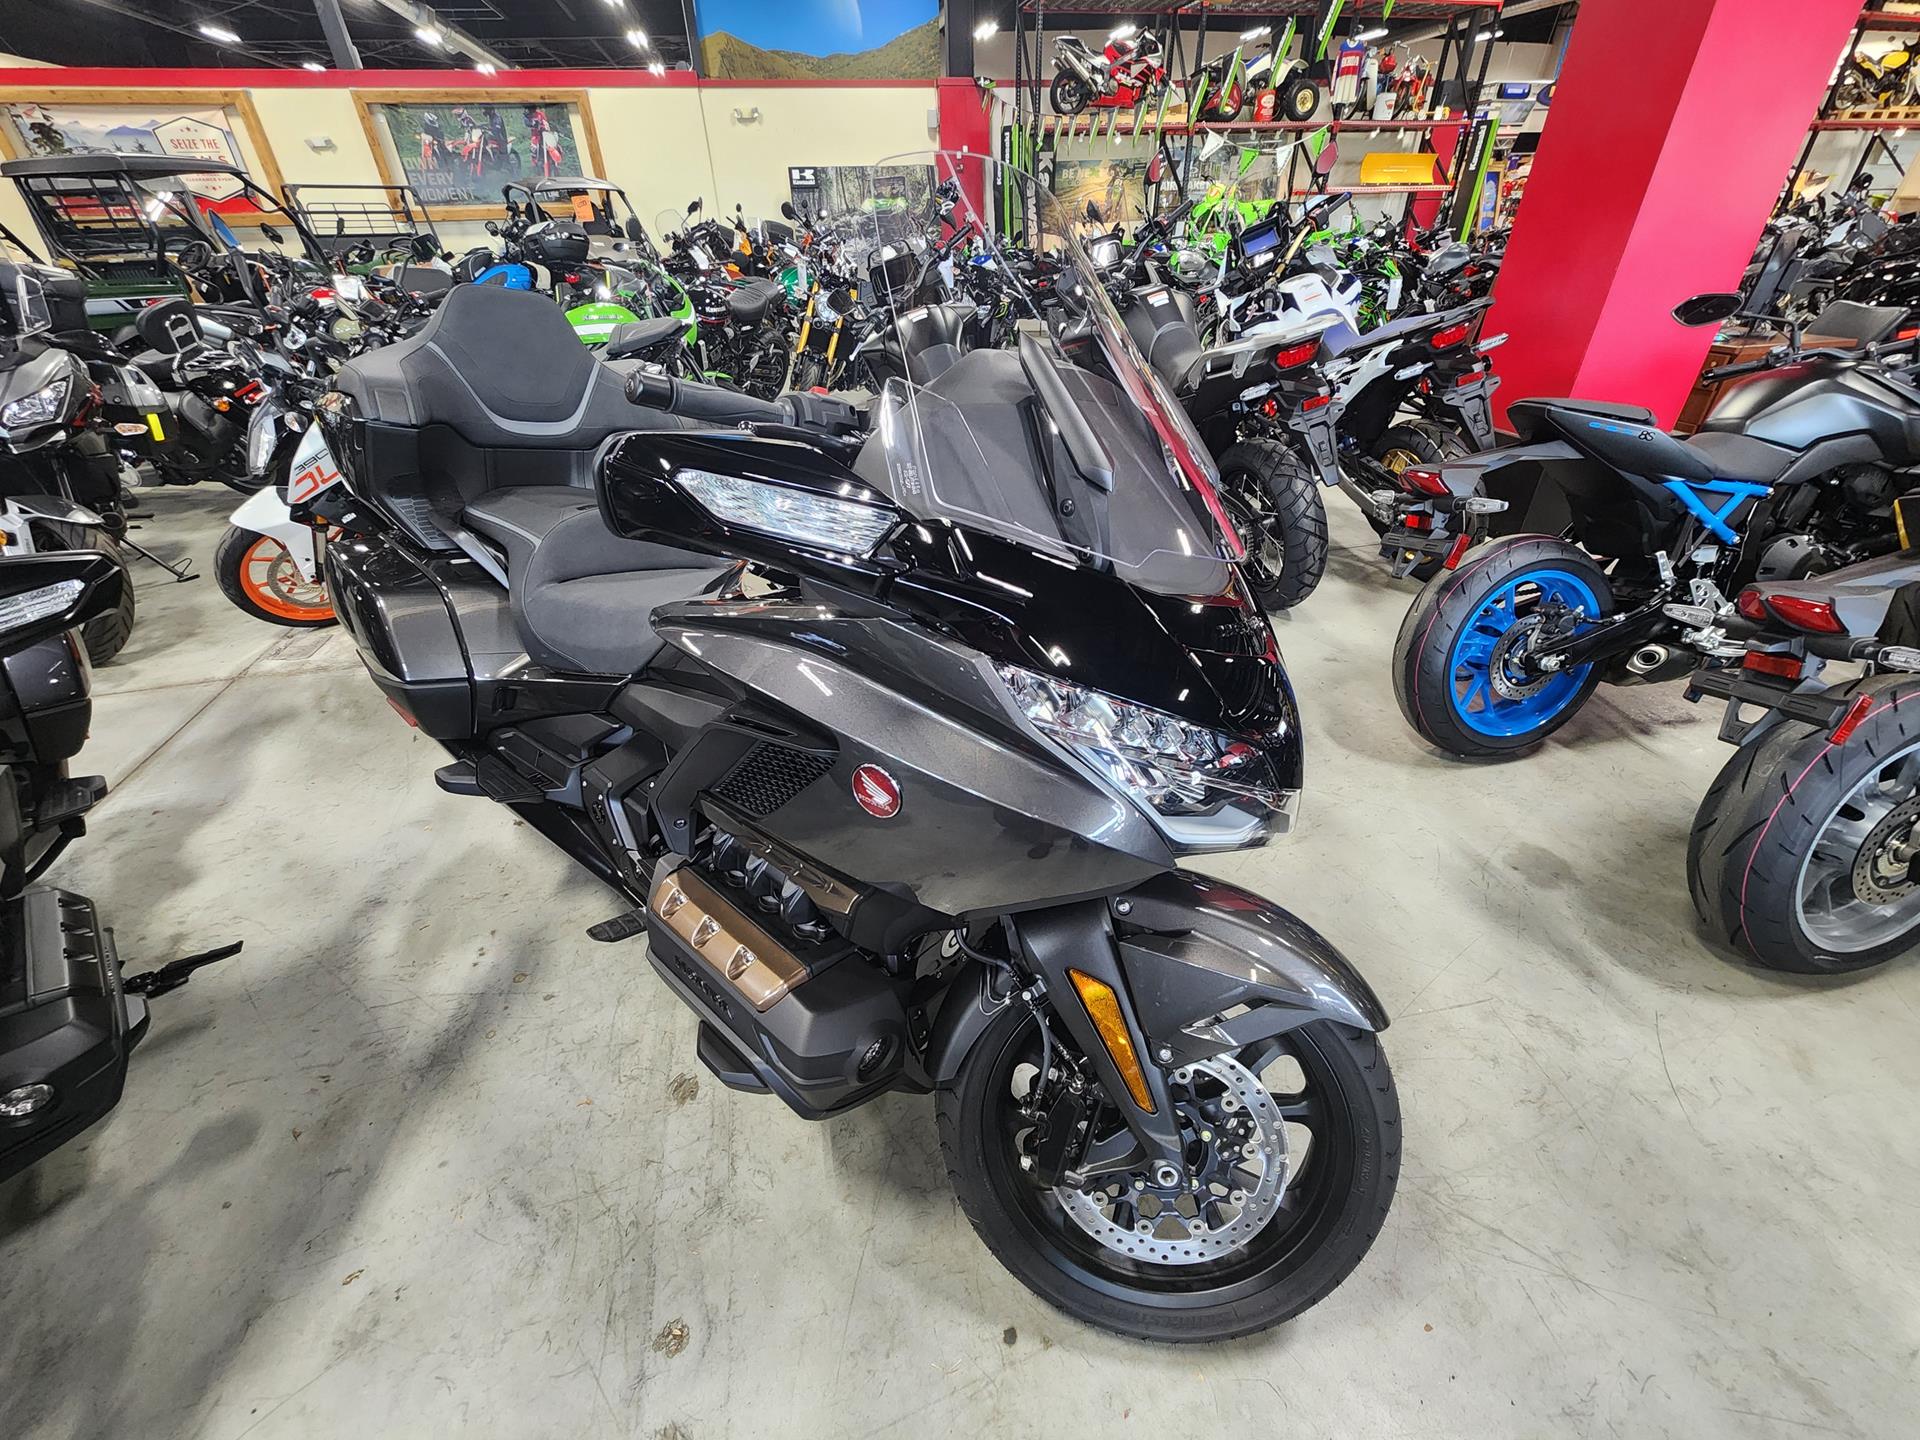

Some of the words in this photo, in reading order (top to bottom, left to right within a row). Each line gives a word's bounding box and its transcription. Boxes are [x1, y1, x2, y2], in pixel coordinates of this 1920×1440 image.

[169, 139, 200, 150] SEIZE
[201, 138, 221, 150] THE
[411, 171, 454, 186] EVERY
[418, 184, 475, 201] MOMENT
[294, 448, 329, 476] 390
[858, 793, 893, 813] HONDA
